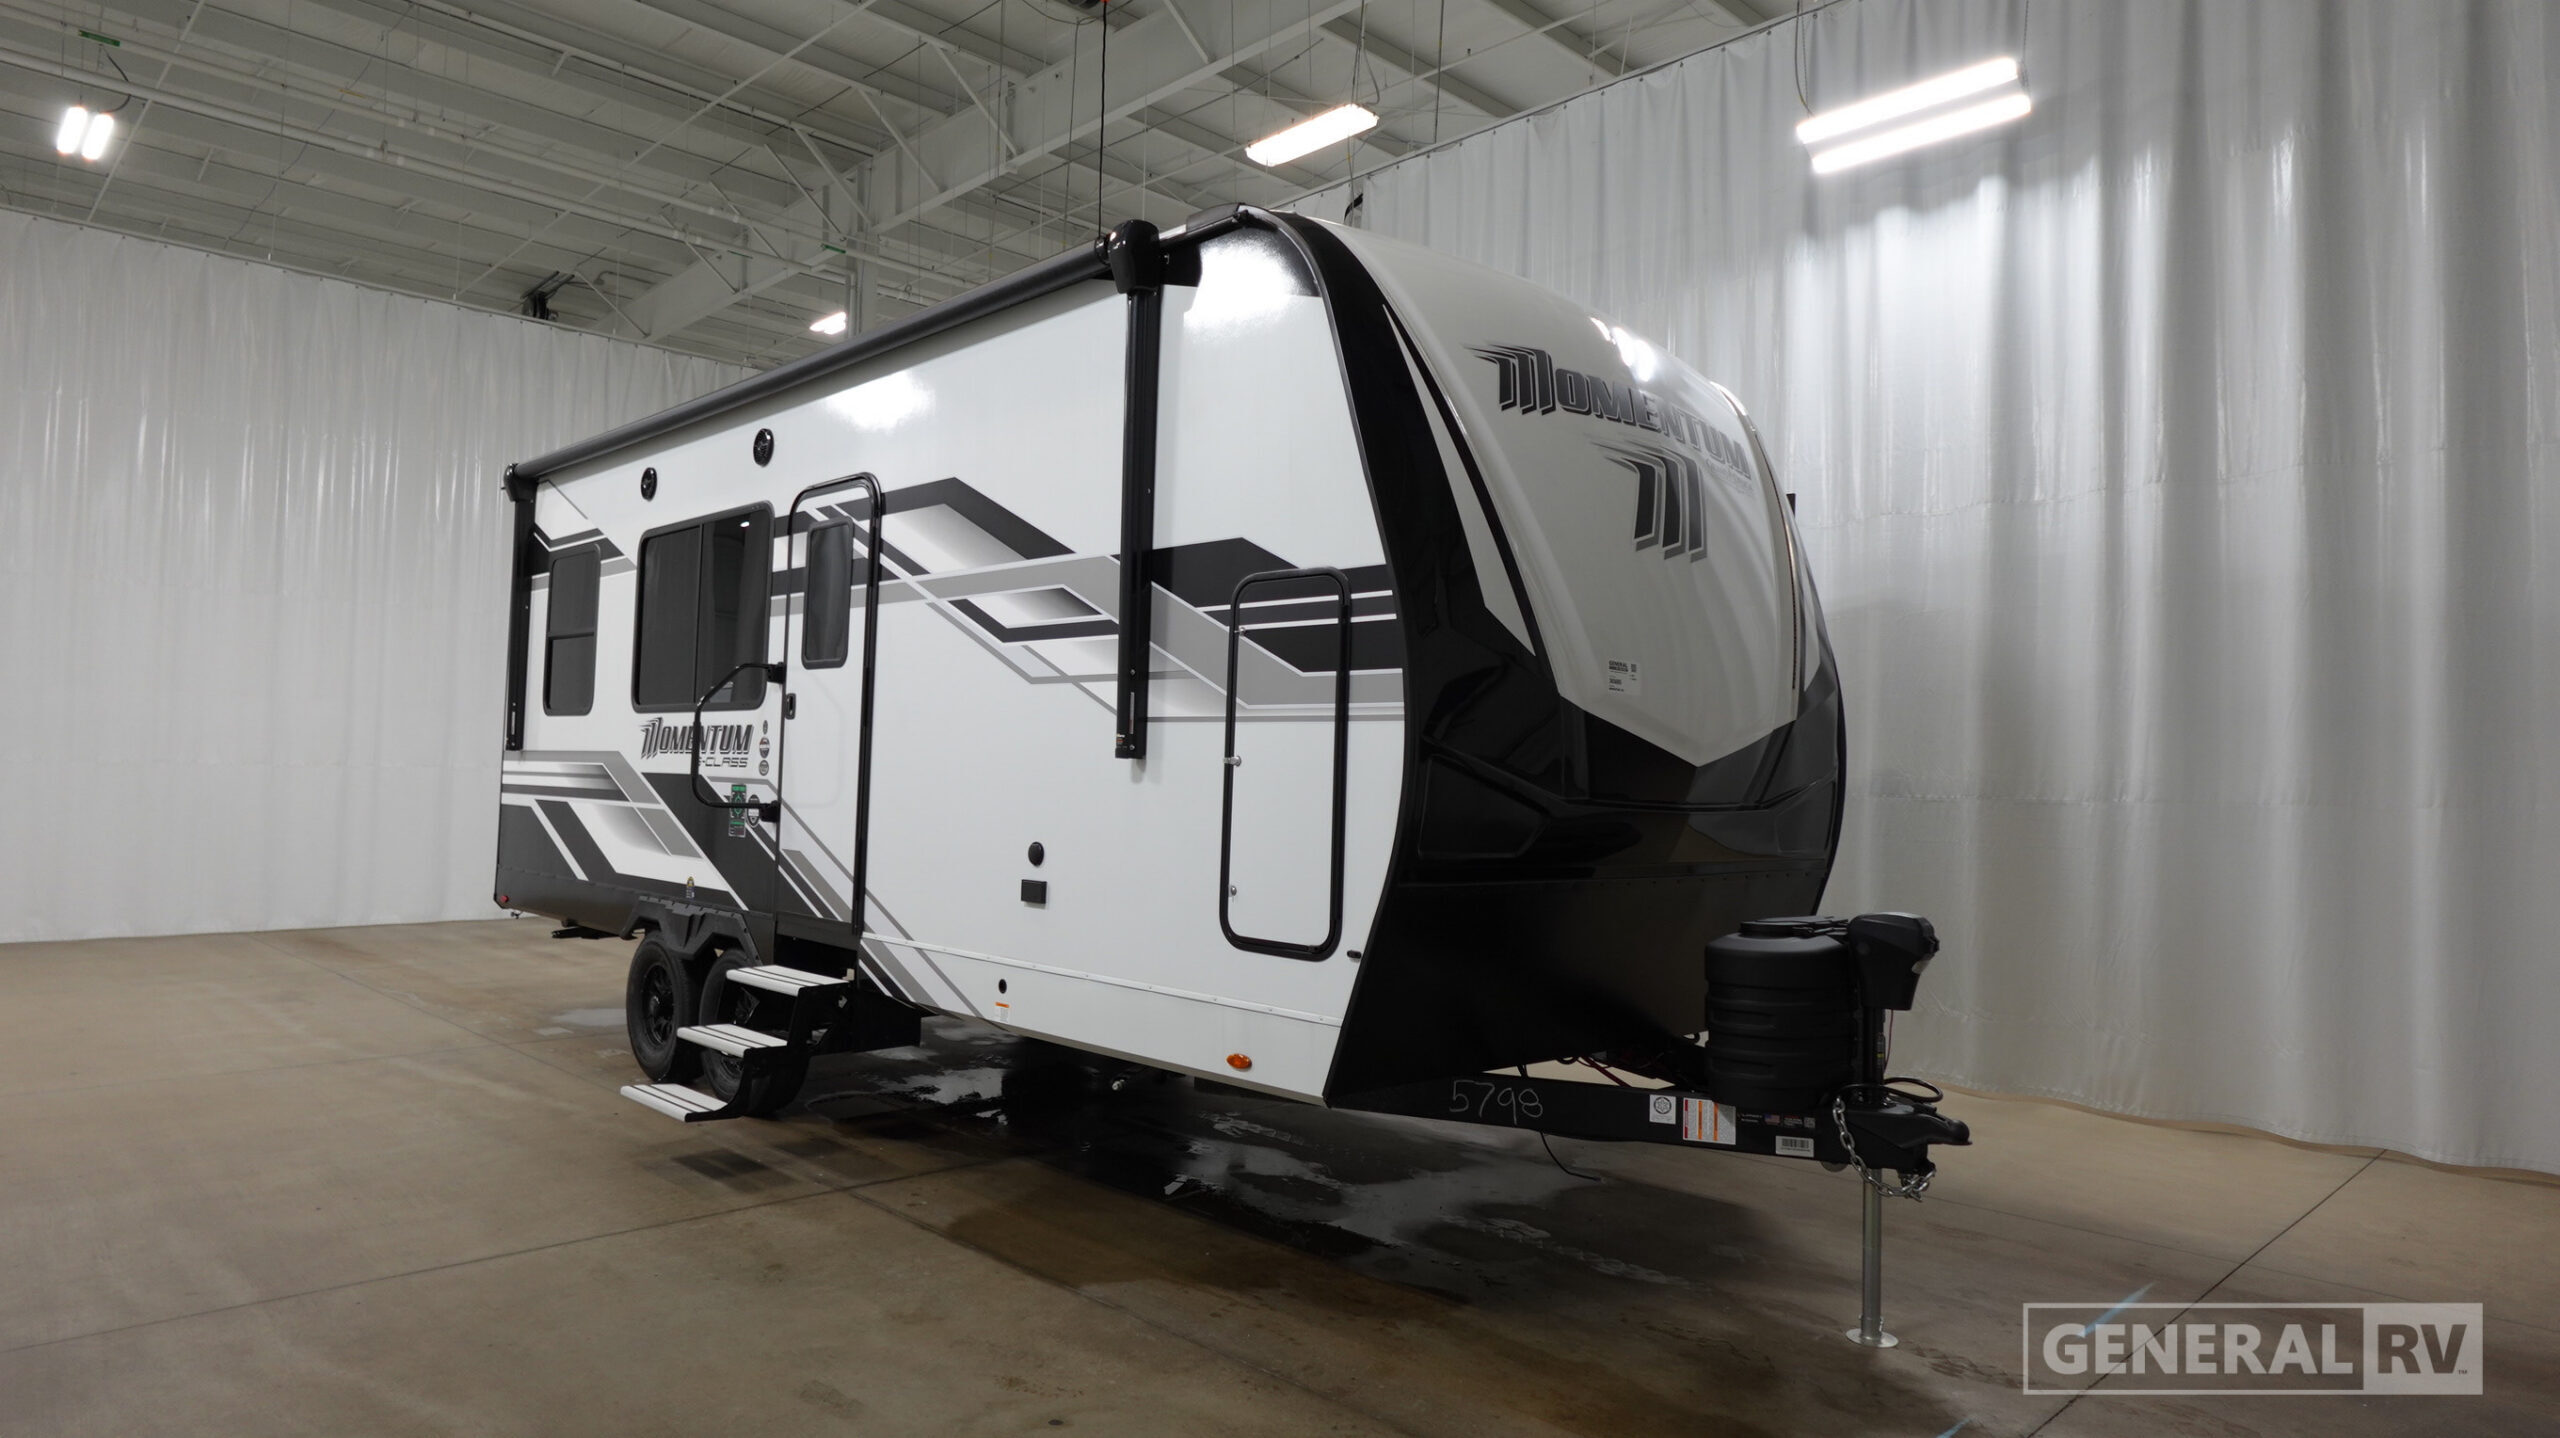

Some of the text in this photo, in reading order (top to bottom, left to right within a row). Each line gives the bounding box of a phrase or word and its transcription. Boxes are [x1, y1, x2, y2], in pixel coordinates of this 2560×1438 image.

[1462, 343, 1752, 480] MOMENTUM
[698, 756, 749, 768] -CLASS
[1449, 1079, 1543, 1125] 5798
